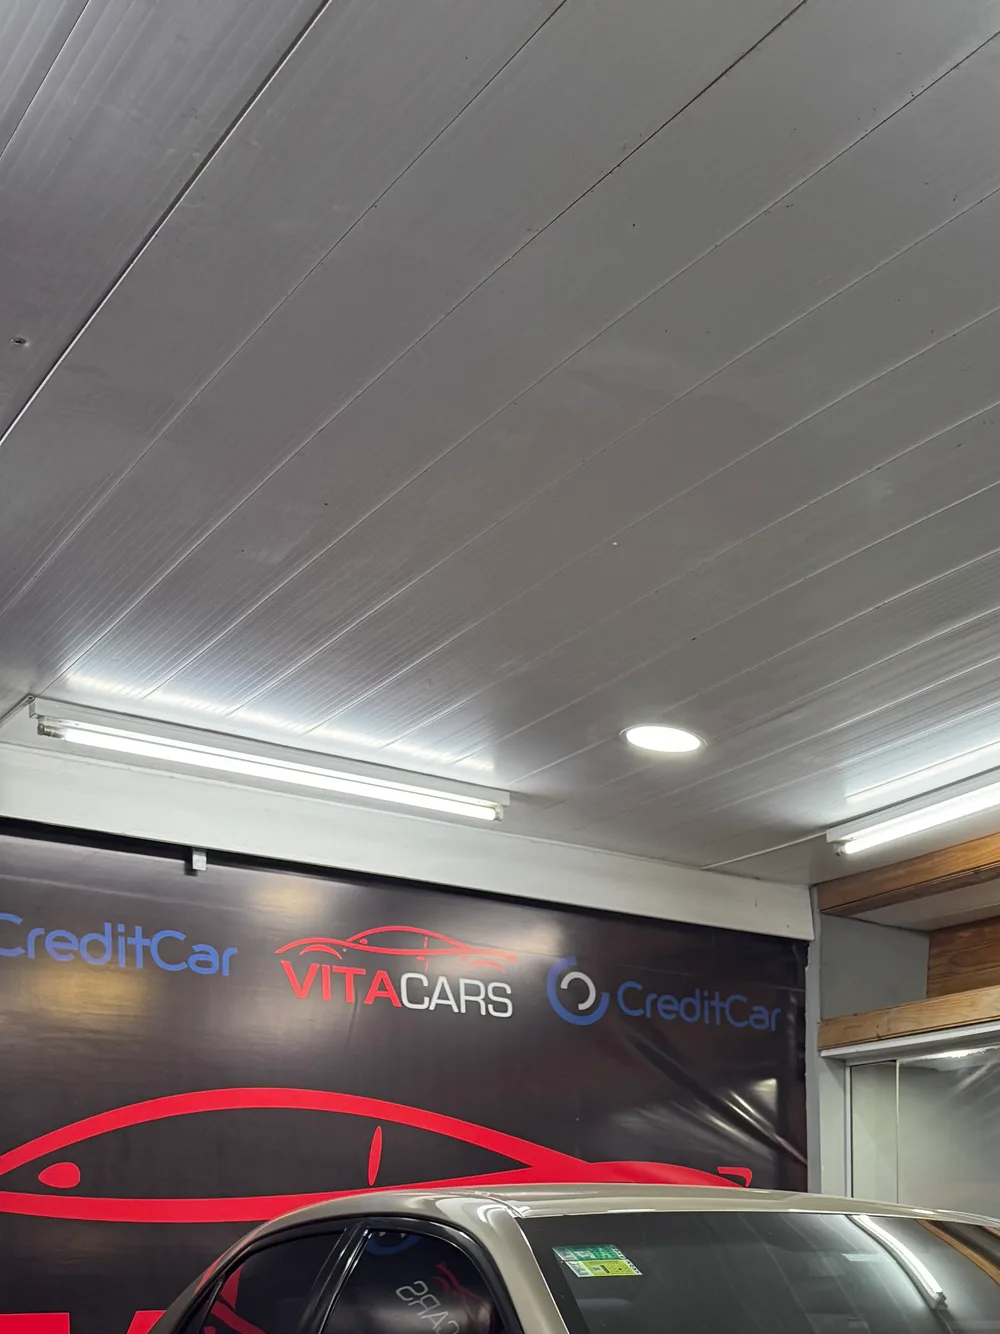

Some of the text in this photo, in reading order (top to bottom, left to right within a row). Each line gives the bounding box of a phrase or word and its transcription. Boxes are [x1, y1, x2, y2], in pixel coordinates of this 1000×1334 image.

[0, 913, 238, 976] CreditCar
[281, 960, 513, 1018] VITACARS
[617, 981, 781, 1031] CreditCar
